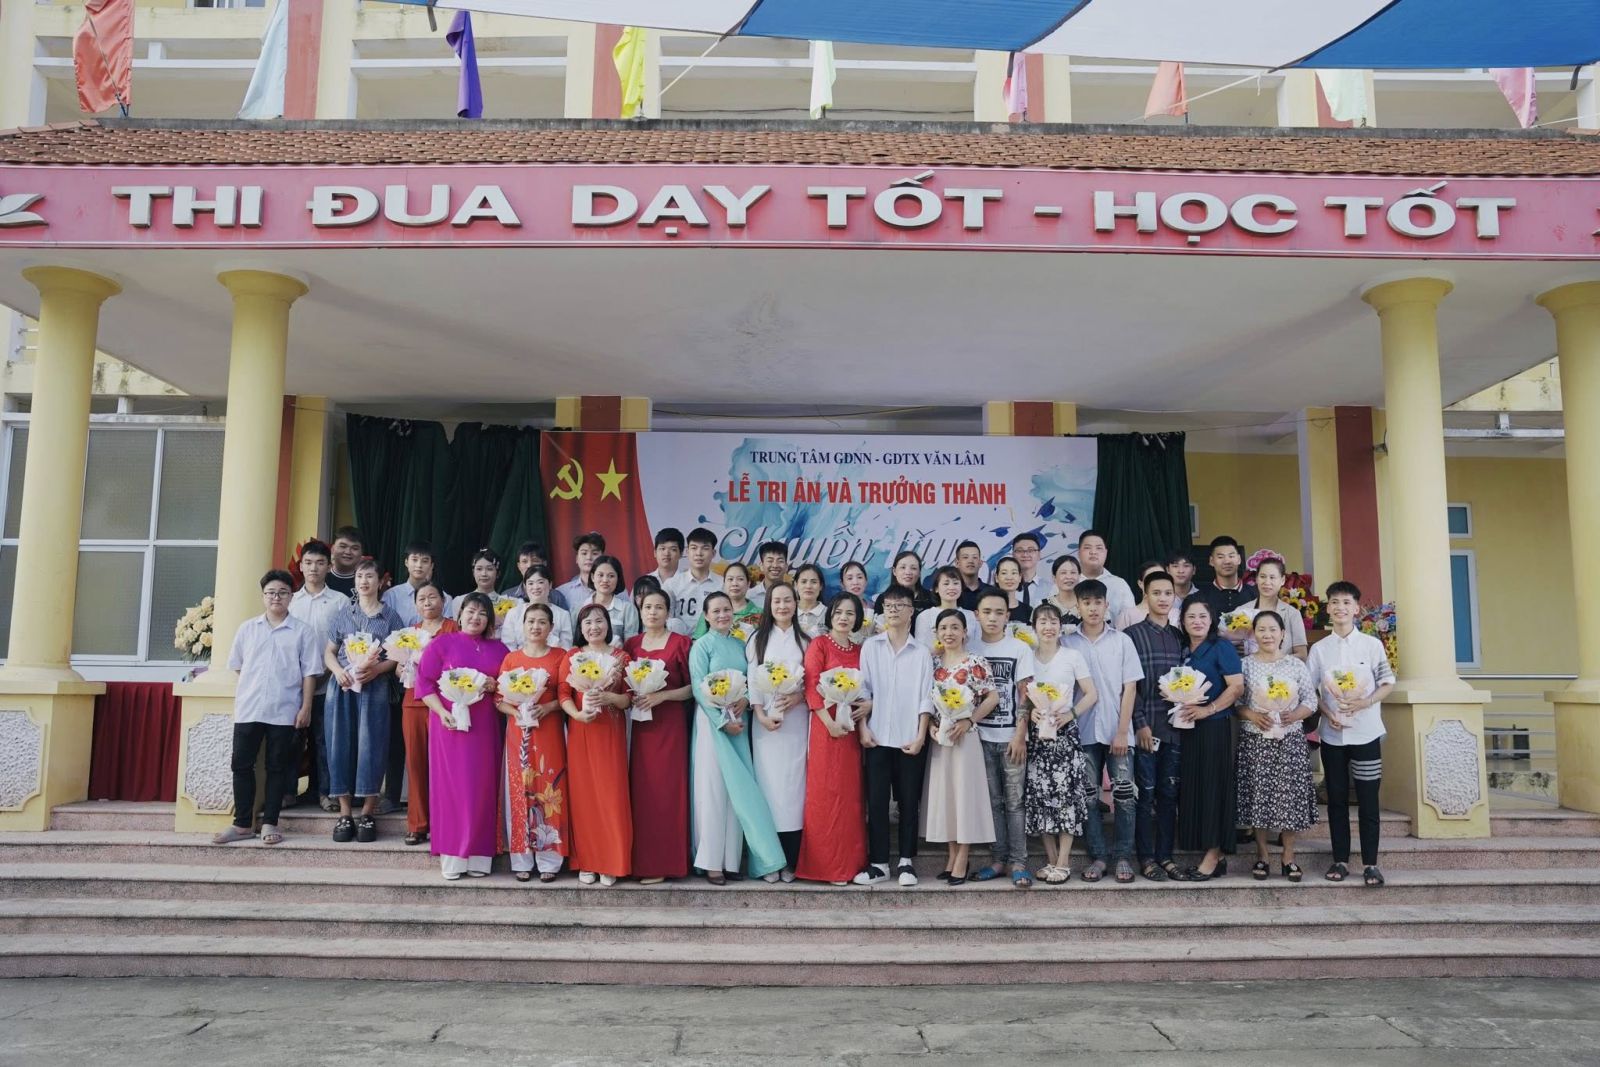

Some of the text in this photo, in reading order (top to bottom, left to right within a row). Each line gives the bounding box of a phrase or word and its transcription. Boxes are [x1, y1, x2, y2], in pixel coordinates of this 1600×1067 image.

[110, 169, 1517, 246] THI ĐUA DẠY TỐT - HỌC TỐT
[750, 451, 797, 464] TRUNG
[800, 448, 830, 464] TÂM
[833, 451, 872, 465] GĐNN
[883, 452, 920, 465] GDTX
[924, 450, 951, 465] VĂN
[955, 449, 985, 466] LÂM
[728, 472, 1006, 505] LỄ TRI ÂN VÀ TRƯỞNG THÀNH
